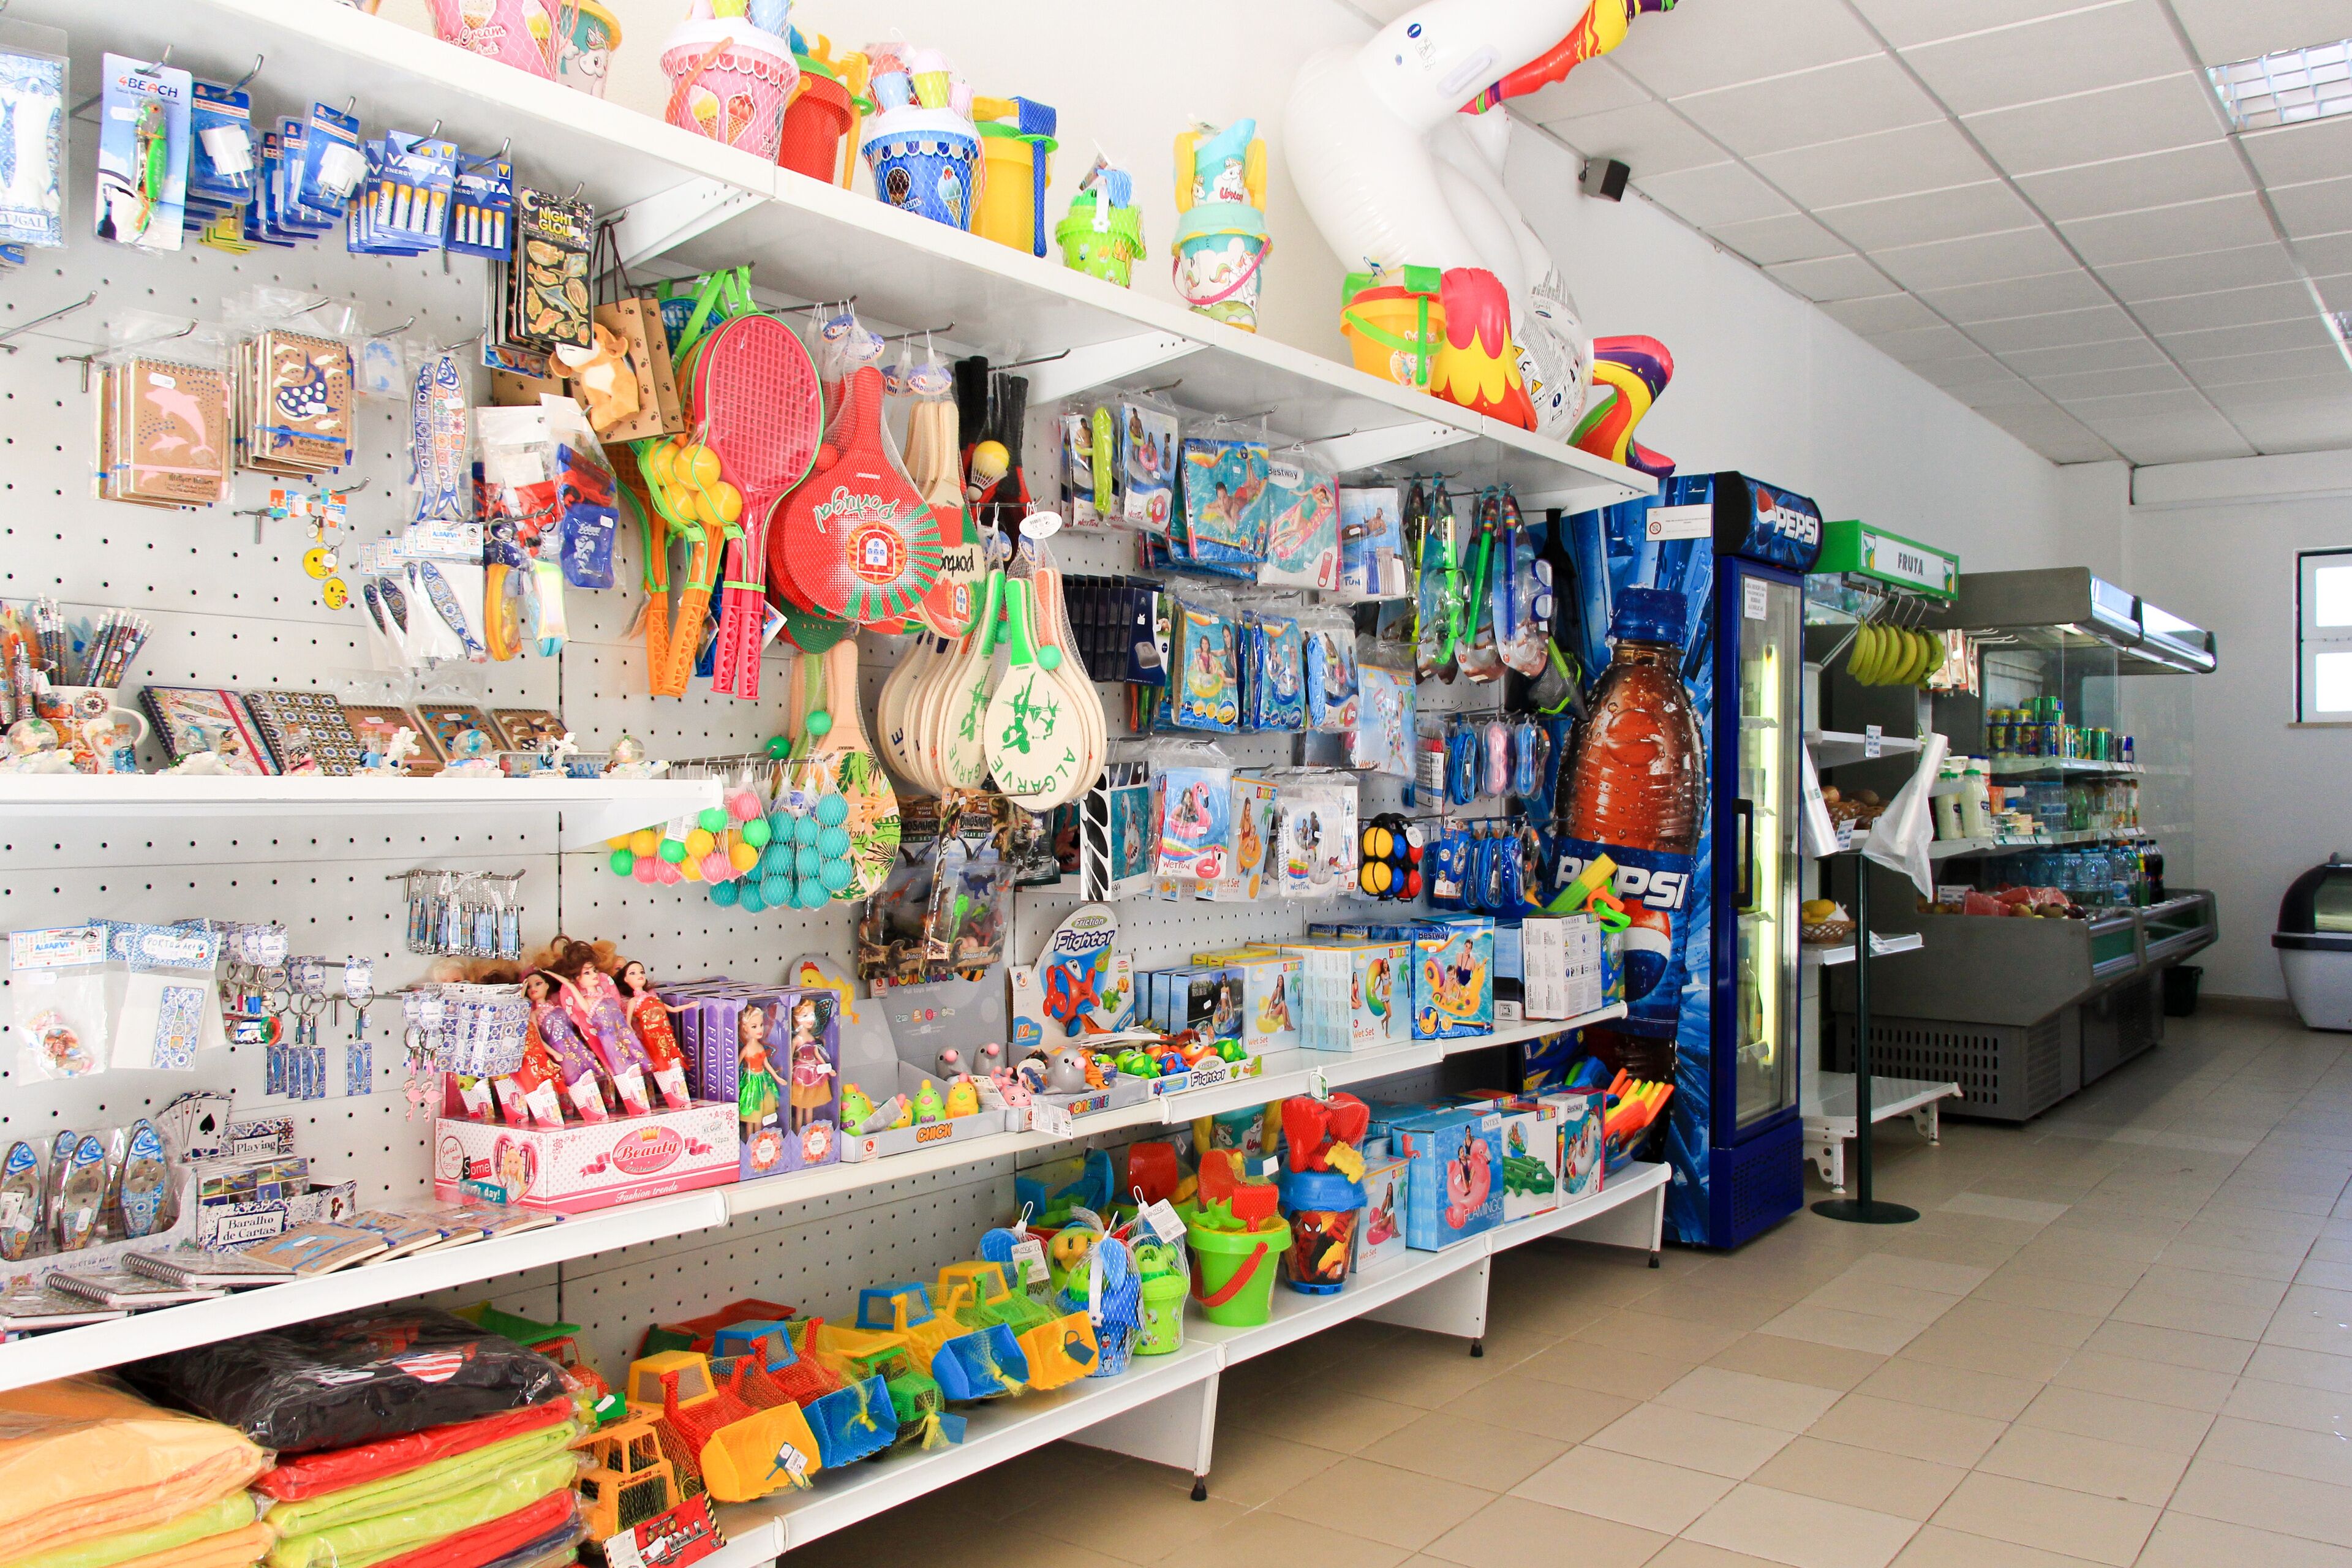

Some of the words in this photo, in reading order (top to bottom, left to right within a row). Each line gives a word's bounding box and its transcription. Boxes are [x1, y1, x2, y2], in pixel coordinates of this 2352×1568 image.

[459, 24, 506, 43] Cream
[118, 75, 178, 98] 4BEACH
[385, 167, 412, 178] ENERGY
[453, 187, 475, 197] NERGY
[1, 213, 46, 228] TUGAL
[539, 206, 575, 227] NIGHT
[1268, 467, 1297, 479] Bestway
[813, 485, 900, 533] Portugal
[1774, 505, 1818, 545] PEPSI
[1898, 552, 1924, 576] FRUTA
[569, 762, 603, 775] ARVE
[949, 743, 981, 783] GARVE
[990, 747, 1076, 793] ALGARVE
[1256, 786, 1277, 801] INTEX
[901, 820, 939, 834] NOSAURS
[960, 814, 992, 828] DINOSAURS
[1231, 878, 1240, 888] Set
[1554, 855, 1689, 910] PPSI
[1075, 917, 1104, 927] Friction
[1311, 926, 1333, 935] Bestway
[1341, 927, 1365, 936] Bestway
[1418, 931, 1450, 942] Bestway
[1054, 929, 1116, 951] Fighter
[1389, 946, 1410, 959] INTEX
[1017, 1023, 1030, 1039] 12
[1352, 1030, 1364, 1038] Wet
[1365, 1028, 1374, 1036] Set
[706, 1025, 717, 1094] FLOWER
[724, 1026, 734, 1096] FLOWER
[1191, 1069, 1226, 1087] Fighter
[1068, 1095, 1110, 1115] HONEYBEE
[1483, 1117, 1499, 1128] INTEX
[916, 1122, 953, 1143] CHICK
[236, 1139, 276, 1153] Playing
[618, 1139, 679, 1161] Beauty
[464, 1159, 491, 1176] Some
[484, 1186, 501, 1201] day!
[615, 1189, 650, 1202] Fashion
[652, 1180, 679, 1196] trends
[1463, 1196, 1504, 1223] FLAMINGO
[228, 1216, 274, 1230] Baralho
[224, 1230, 236, 1241] de
[238, 1227, 276, 1239] Cartas
